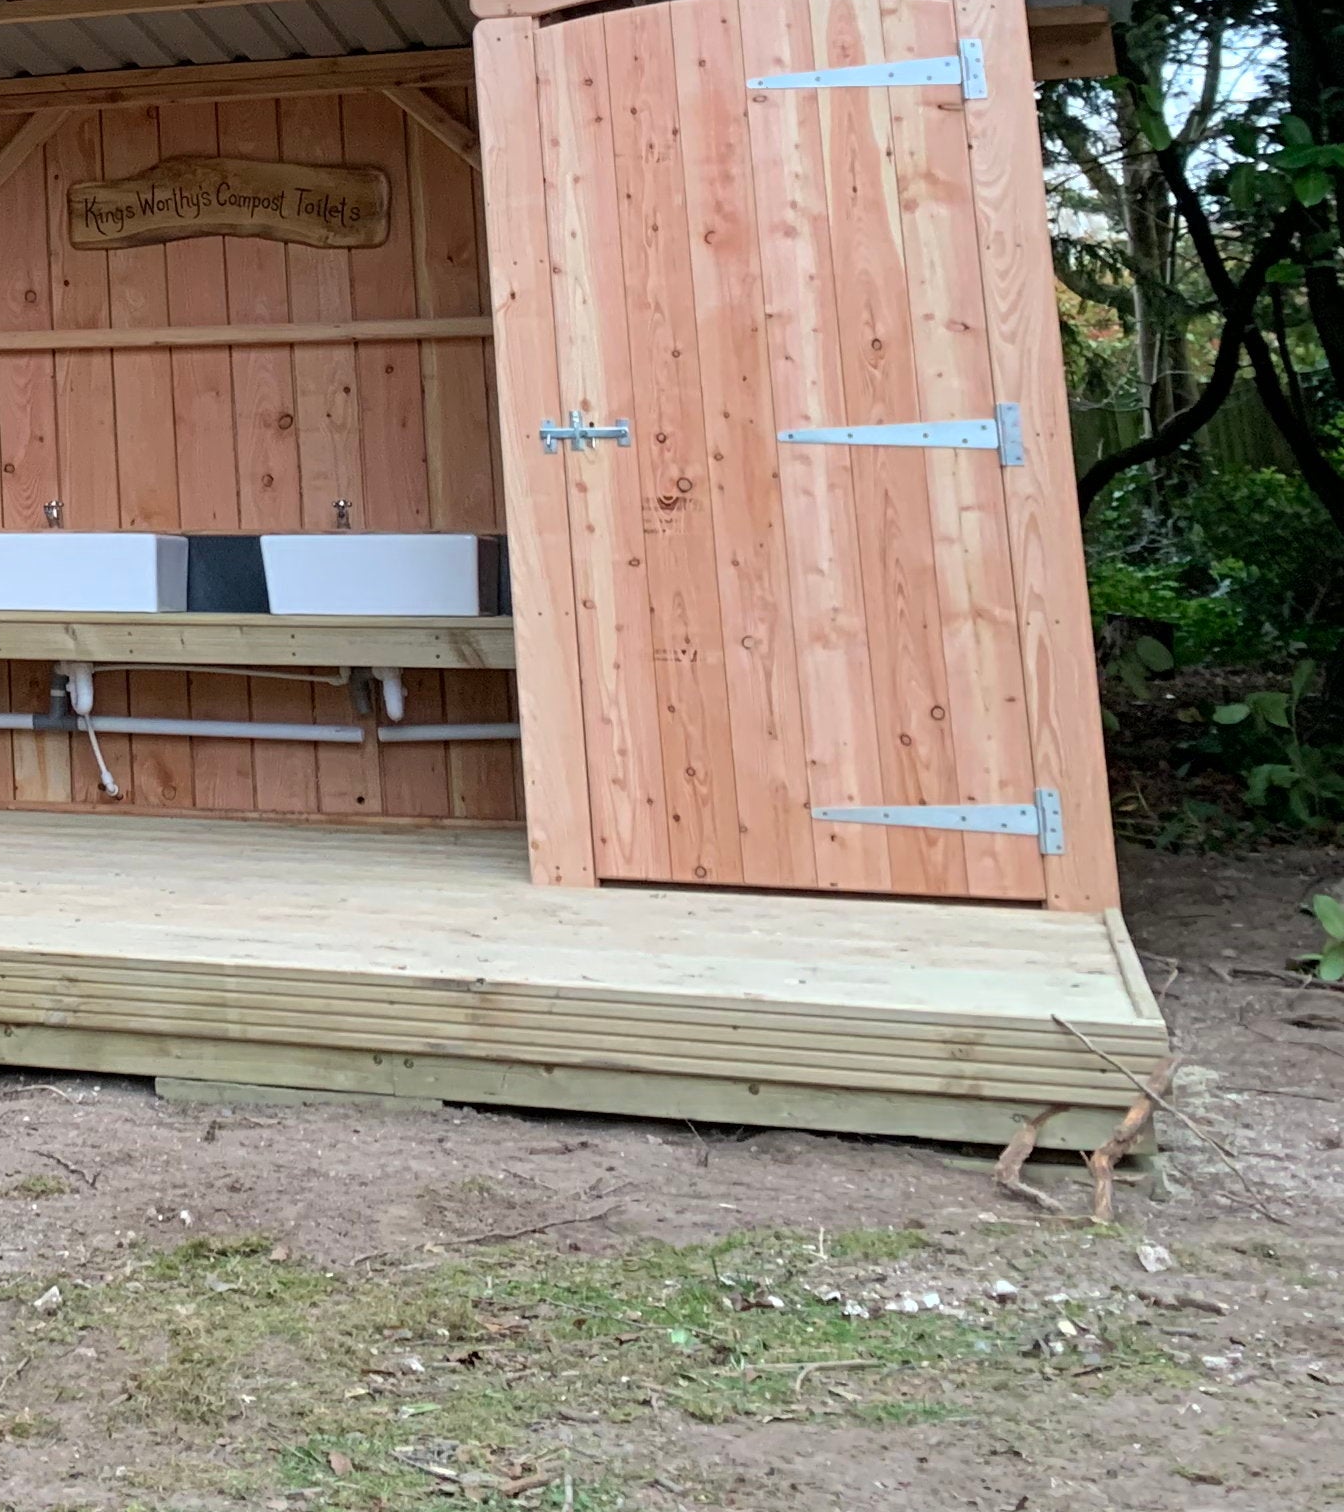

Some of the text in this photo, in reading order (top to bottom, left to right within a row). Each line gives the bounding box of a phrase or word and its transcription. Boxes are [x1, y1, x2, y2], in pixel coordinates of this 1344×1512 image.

[84, 182, 362, 236] Kings Worthy's Compost Toilets
